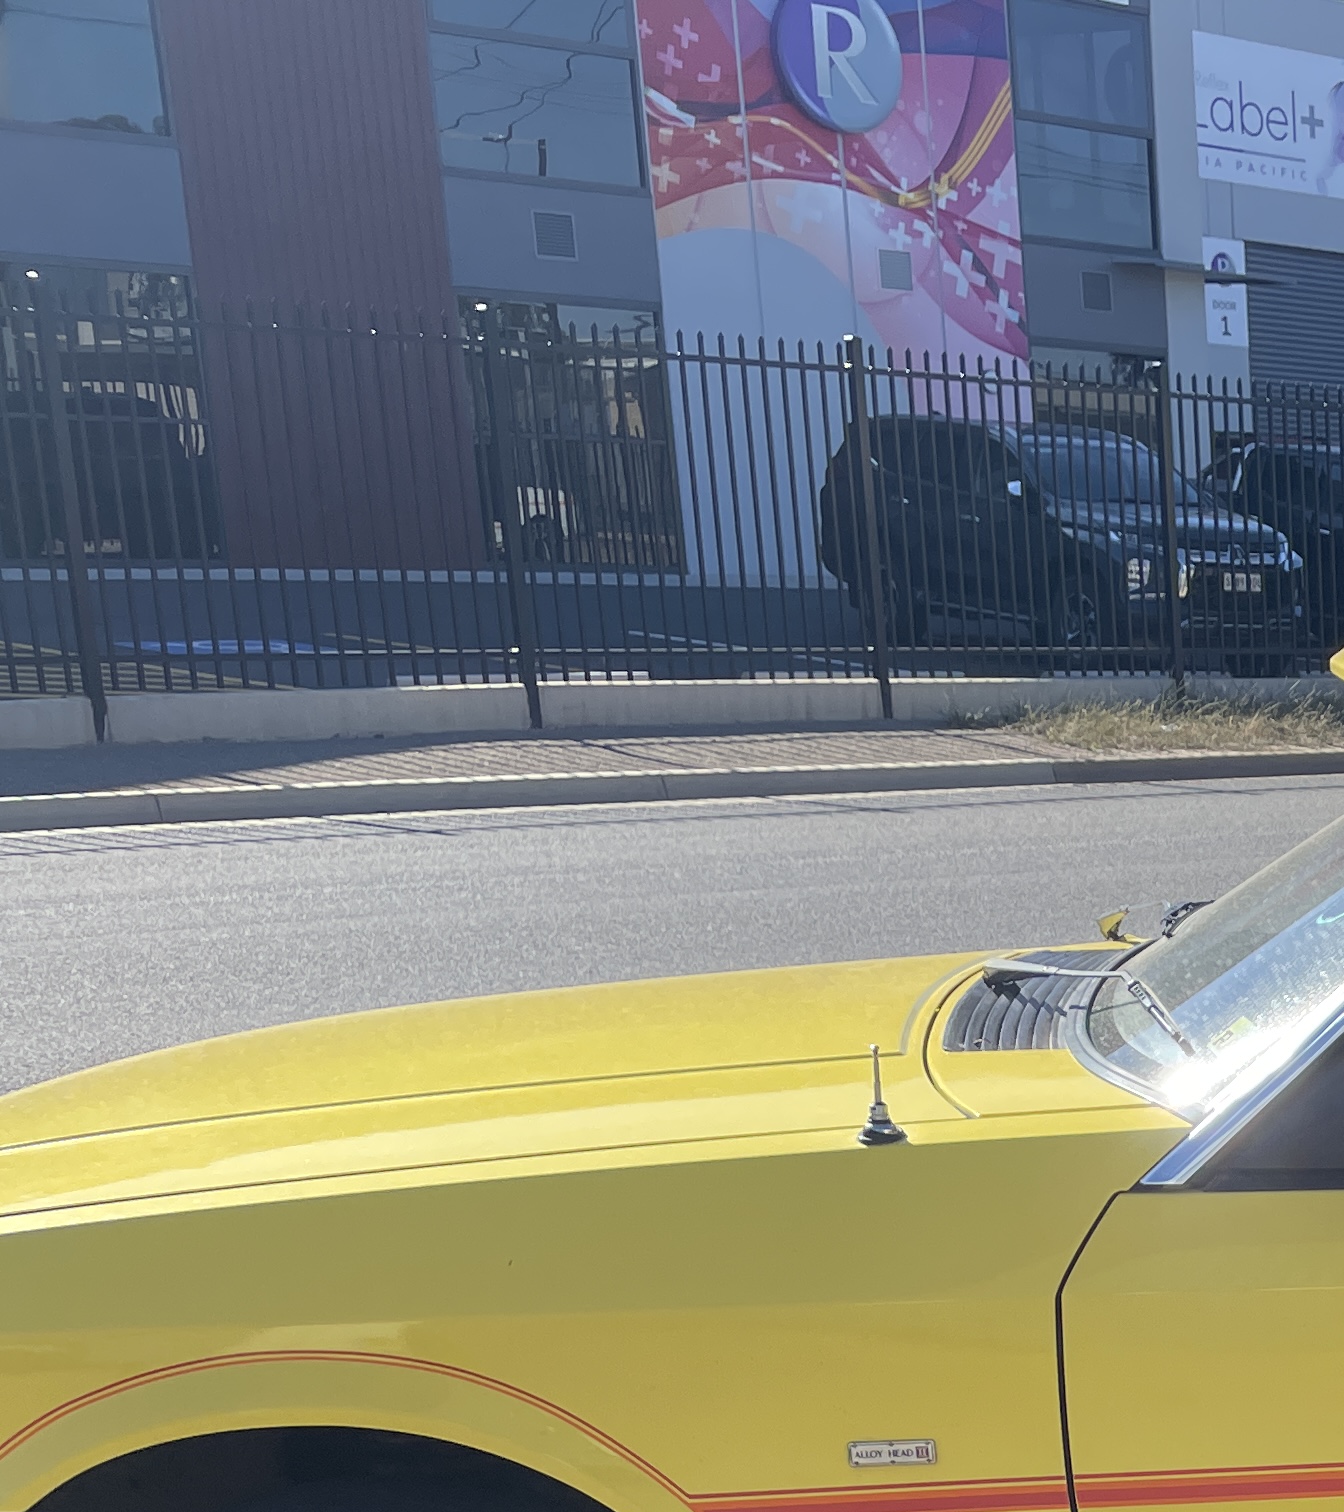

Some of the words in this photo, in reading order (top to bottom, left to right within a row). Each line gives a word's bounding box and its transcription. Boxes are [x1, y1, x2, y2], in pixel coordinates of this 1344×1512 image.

[811, 3, 879, 106] R
[1236, 160, 1308, 182] PACIFIC
[1221, 316, 1232, 336] 1
[855, 1449, 883, 1459] ALLOY
[888, 1448, 914, 1458] HEAD
